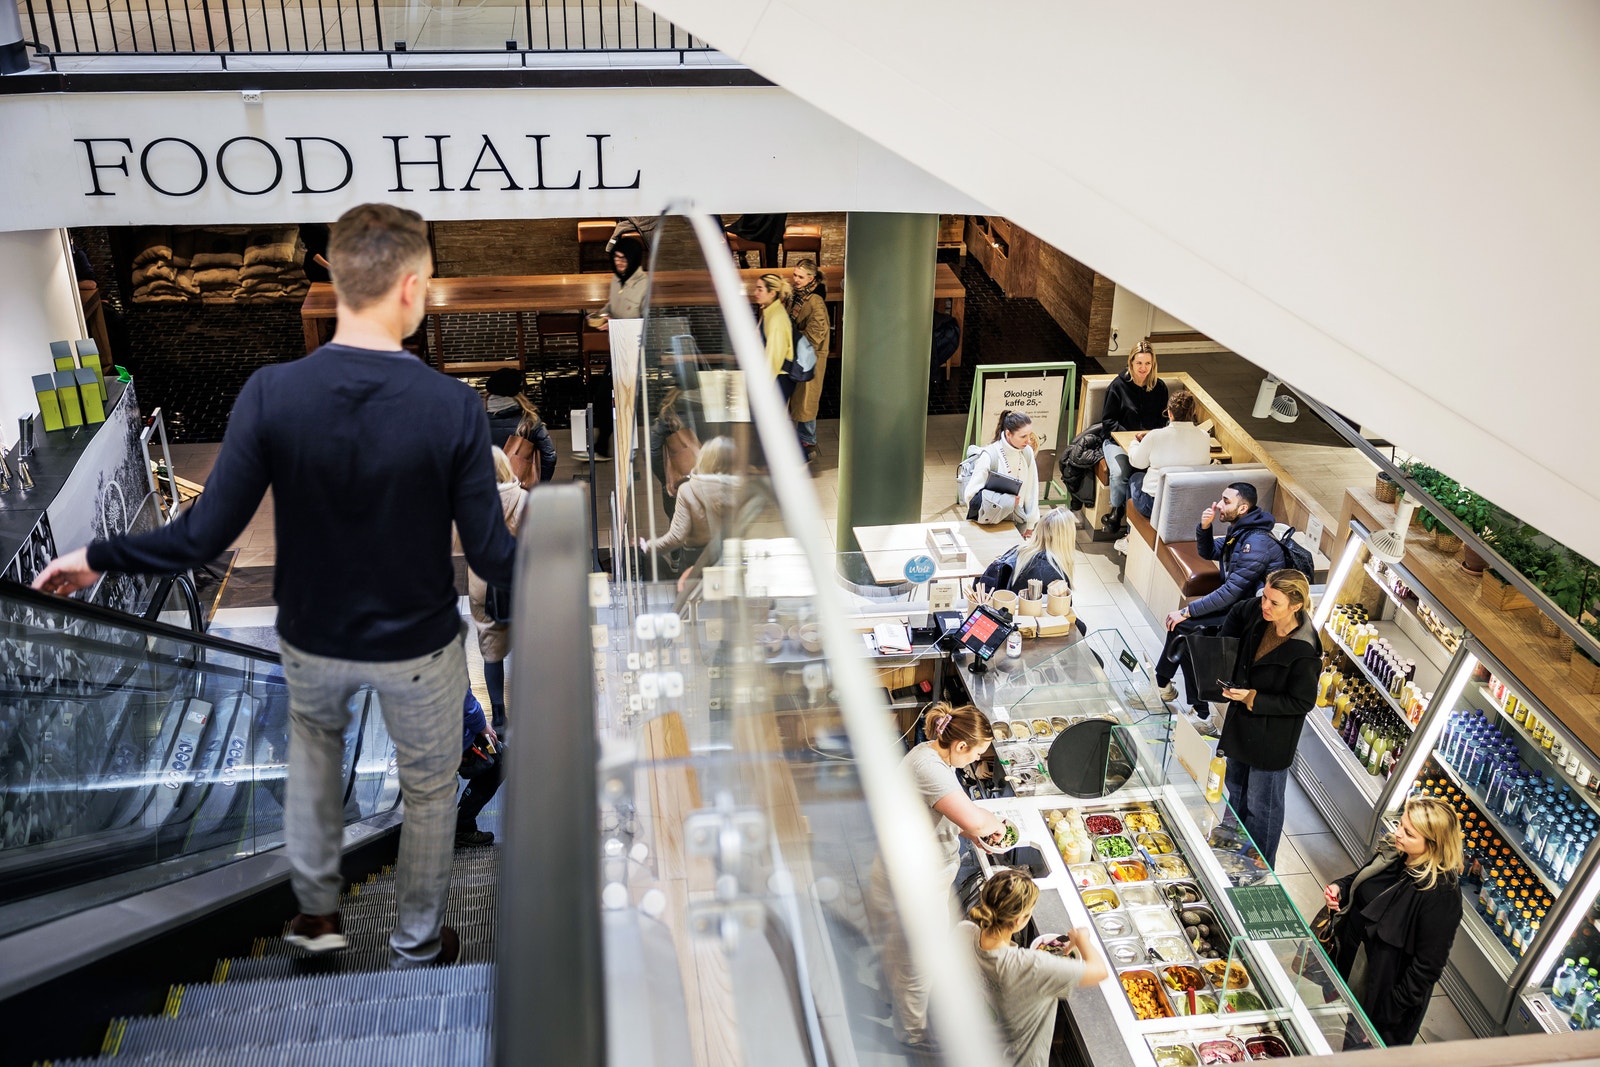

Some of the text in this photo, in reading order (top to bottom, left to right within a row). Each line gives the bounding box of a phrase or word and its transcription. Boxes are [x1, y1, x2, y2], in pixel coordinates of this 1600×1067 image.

[74, 135, 641, 196] FOOD HALL
[1003, 389, 1043, 399] Økologisk
[1005, 399, 1042, 407] kaffe 25,-
[909, 565, 930, 573] Wolt
